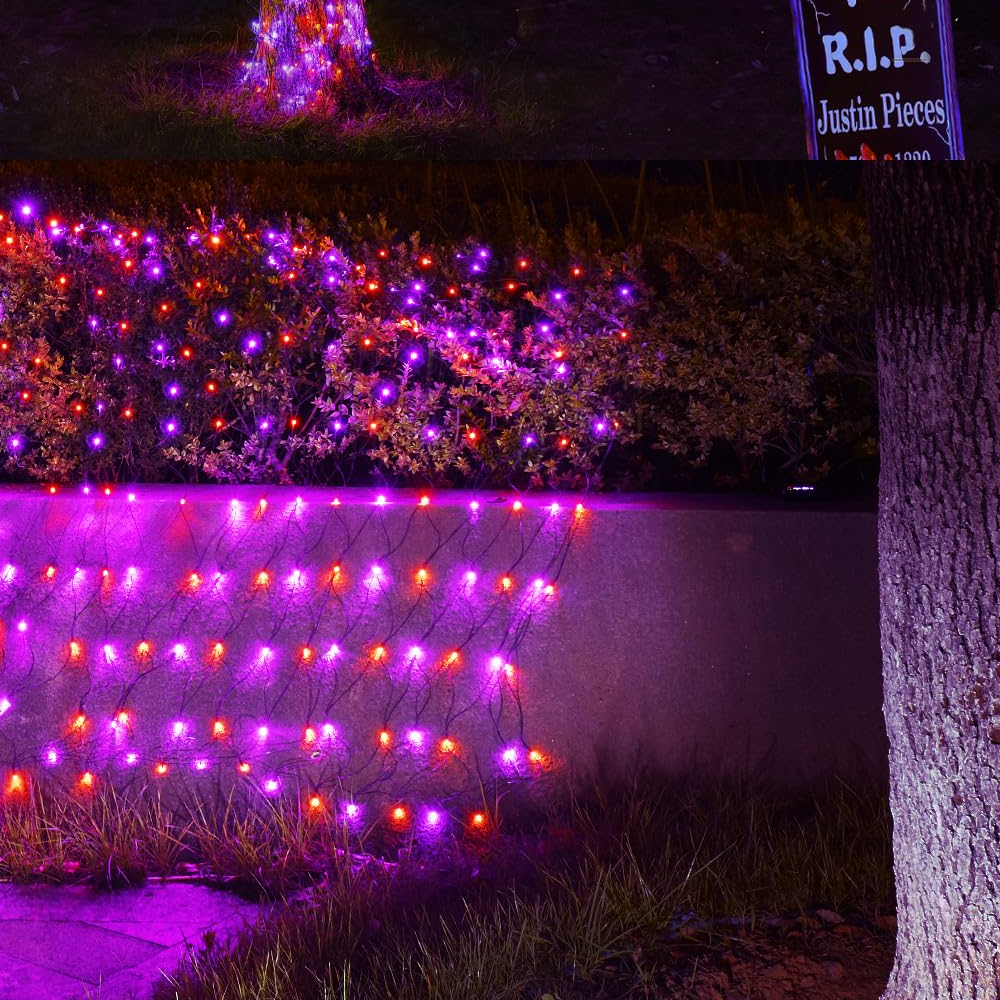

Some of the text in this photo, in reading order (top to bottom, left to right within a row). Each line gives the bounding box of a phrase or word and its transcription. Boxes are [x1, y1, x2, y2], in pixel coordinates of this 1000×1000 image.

[822, 26, 931, 74] R.I.P.
[817, 91, 945, 135] Justin Pieces
